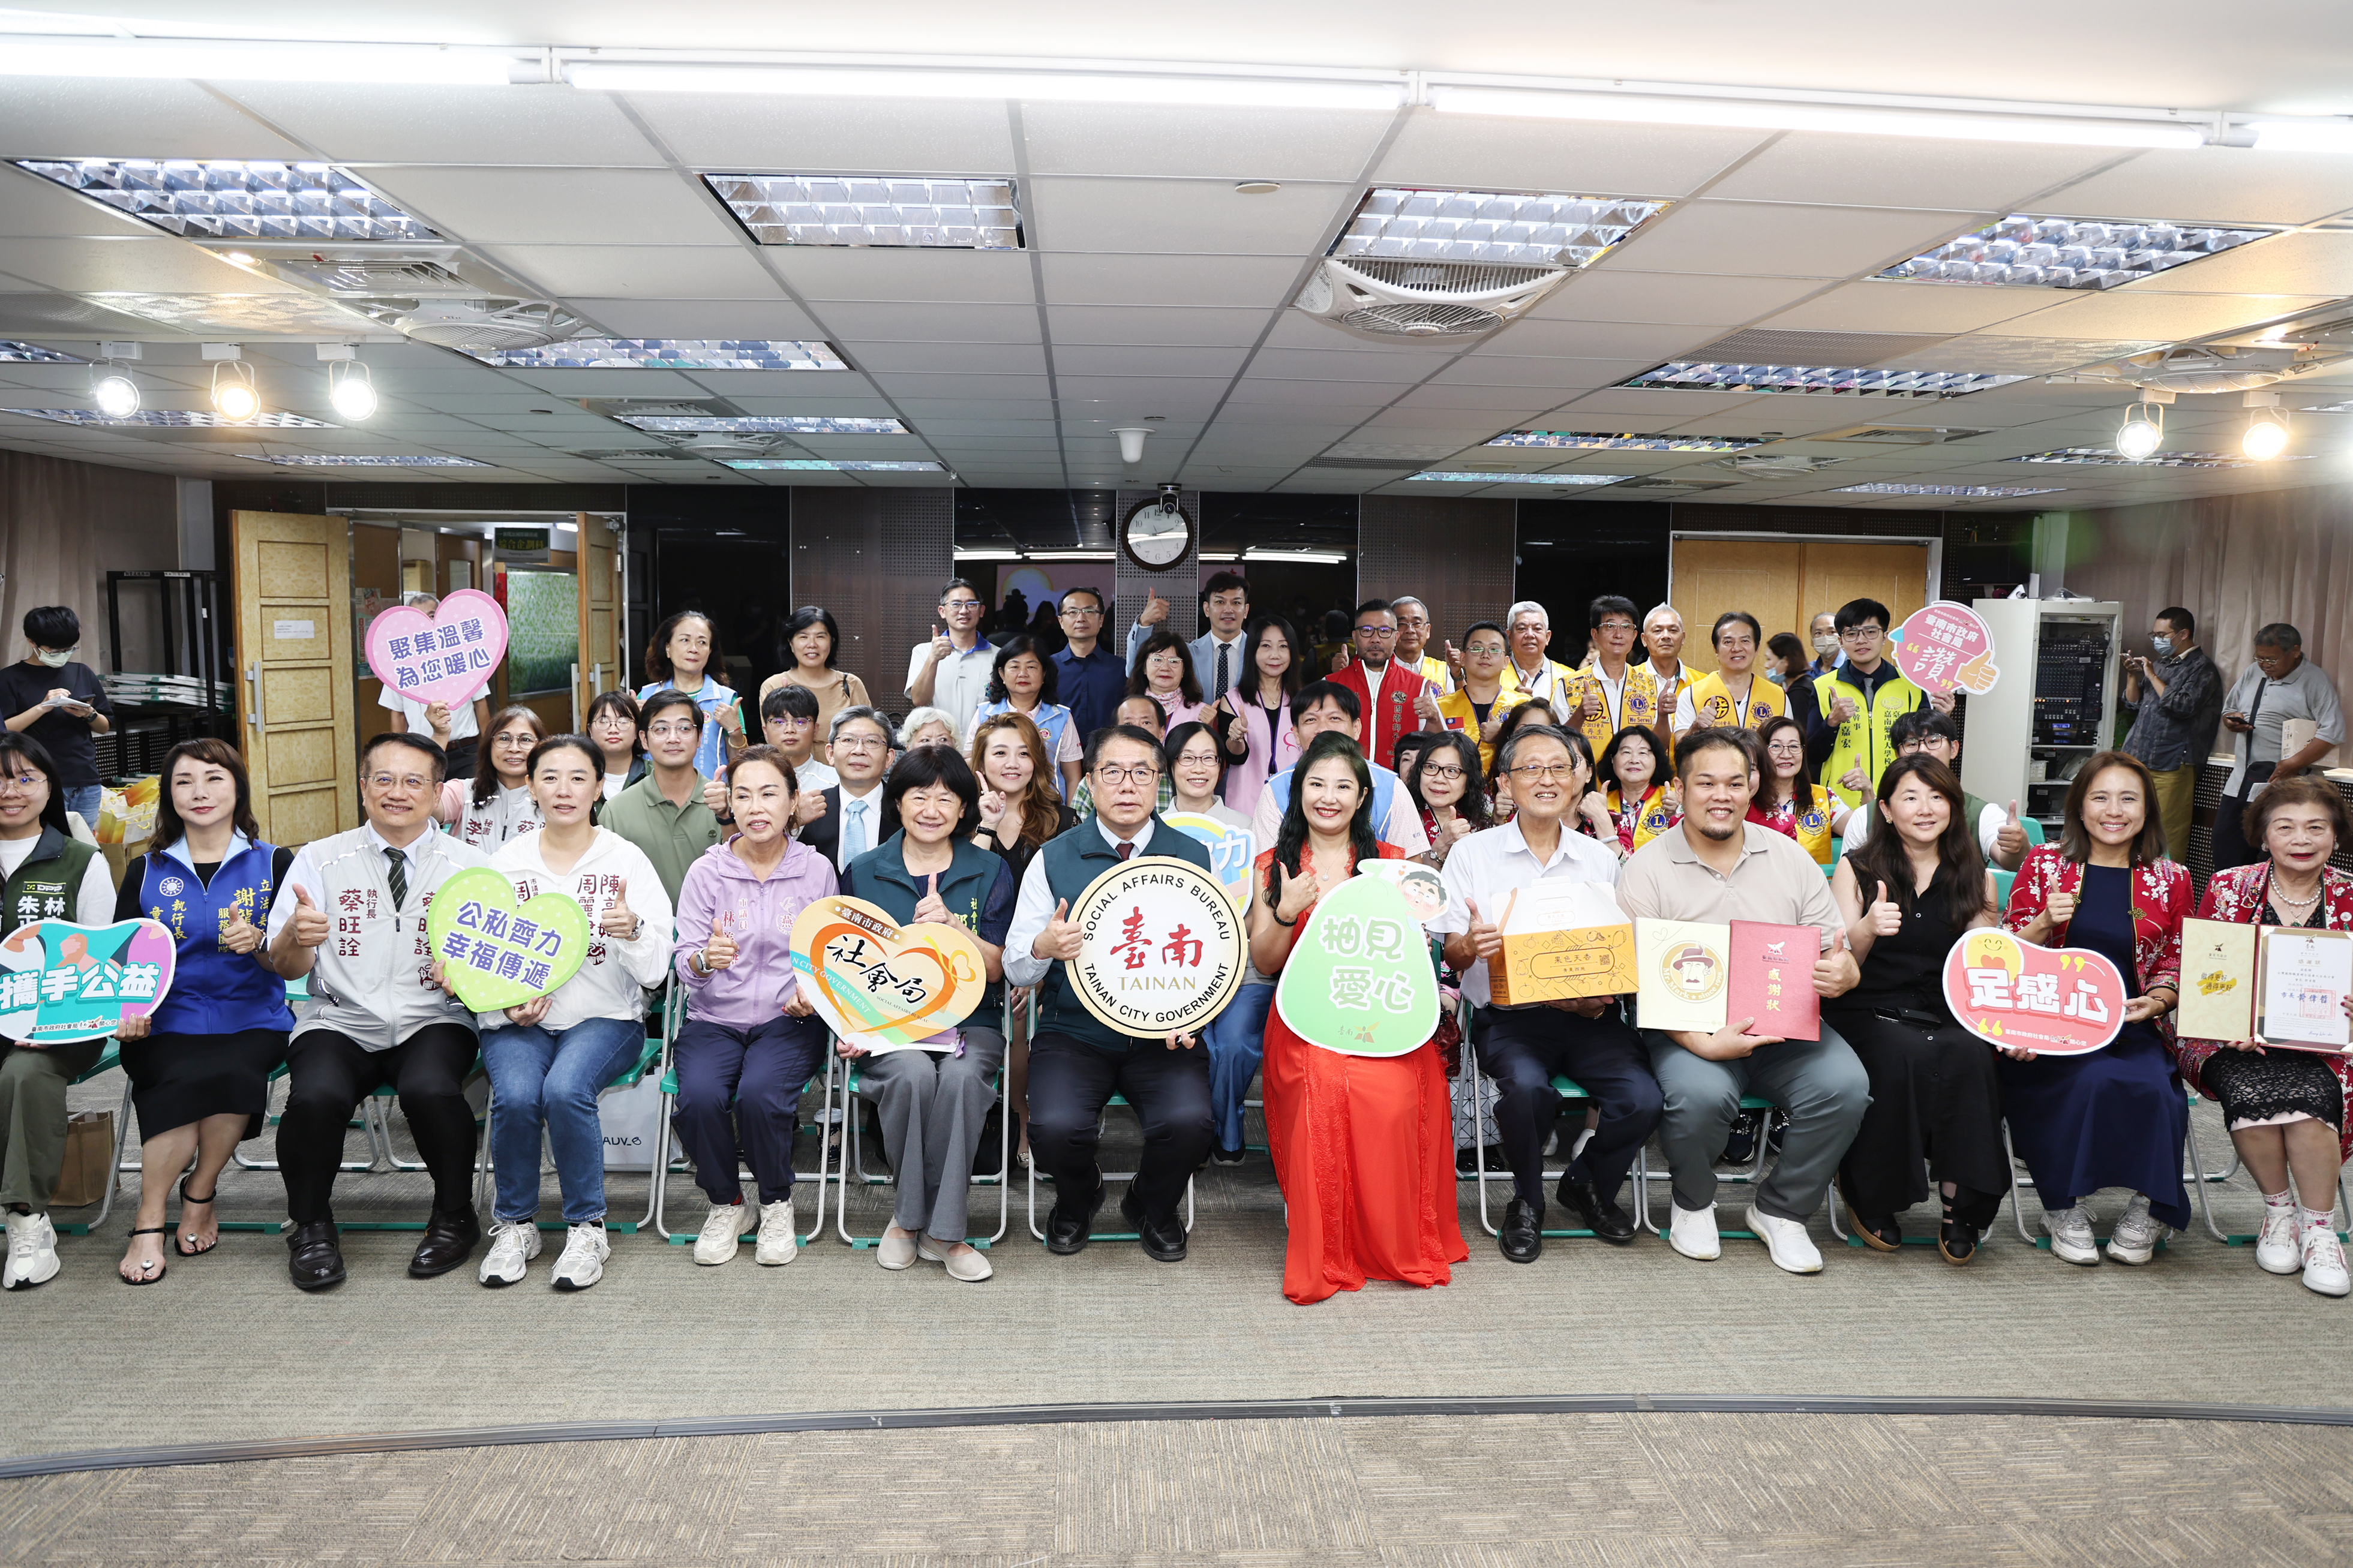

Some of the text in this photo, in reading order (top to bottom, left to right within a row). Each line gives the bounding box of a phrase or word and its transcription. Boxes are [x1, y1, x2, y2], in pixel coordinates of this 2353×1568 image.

[388, 618, 484, 660] 聚集溫馨
[1924, 614, 1979, 642] 臺南市政府
[1931, 628, 1964, 648] 社會局
[396, 647, 491, 689] 為您暖心
[1913, 645, 1957, 683] 讚
[44, 897, 65, 920] 林
[170, 899, 188, 940] 執行長
[257, 879, 272, 931] 立法委
[338, 888, 364, 956] 蔡旺詮
[366, 888, 378, 919] 執行長
[738, 898, 748, 930] 市議員
[840, 906, 893, 939] 臺南市政府
[1083, 874, 1230, 941] SOCIAL AFFAIRS BUREAU
[457, 902, 562, 957] 公私齊力
[1110, 906, 1203, 970] 臺南
[1320, 915, 1403, 961] 柚見
[442, 932, 551, 990] 幸福傳遞
[826, 935, 927, 1004] 社會局
[1554, 953, 1592, 964] 果色天香
[2201, 972, 2228, 982] 做得更好
[0, 963, 157, 1010] 攜手公益
[799, 960, 820, 974] CITY
[820, 969, 871, 1013] GOVERNMENT
[1085, 963, 1229, 1022] TAINAN CITY GOVERNMENT
[1117, 977, 1196, 990] TAINAN
[1331, 968, 1413, 1011] 愛心
[1698, 987, 1717, 999] since
[1766, 968, 1782, 1011] 感謝狀
[1966, 968, 2109, 1023] 足感心
[2205, 982, 2232, 992] 過得更好
[31, 1022, 78, 1032] 臺南市政府社會局
[876, 995, 929, 1024] SOCIAL AFFAIRS BUREAU
[2005, 1028, 2049, 1041] 臺南市政府社會局
